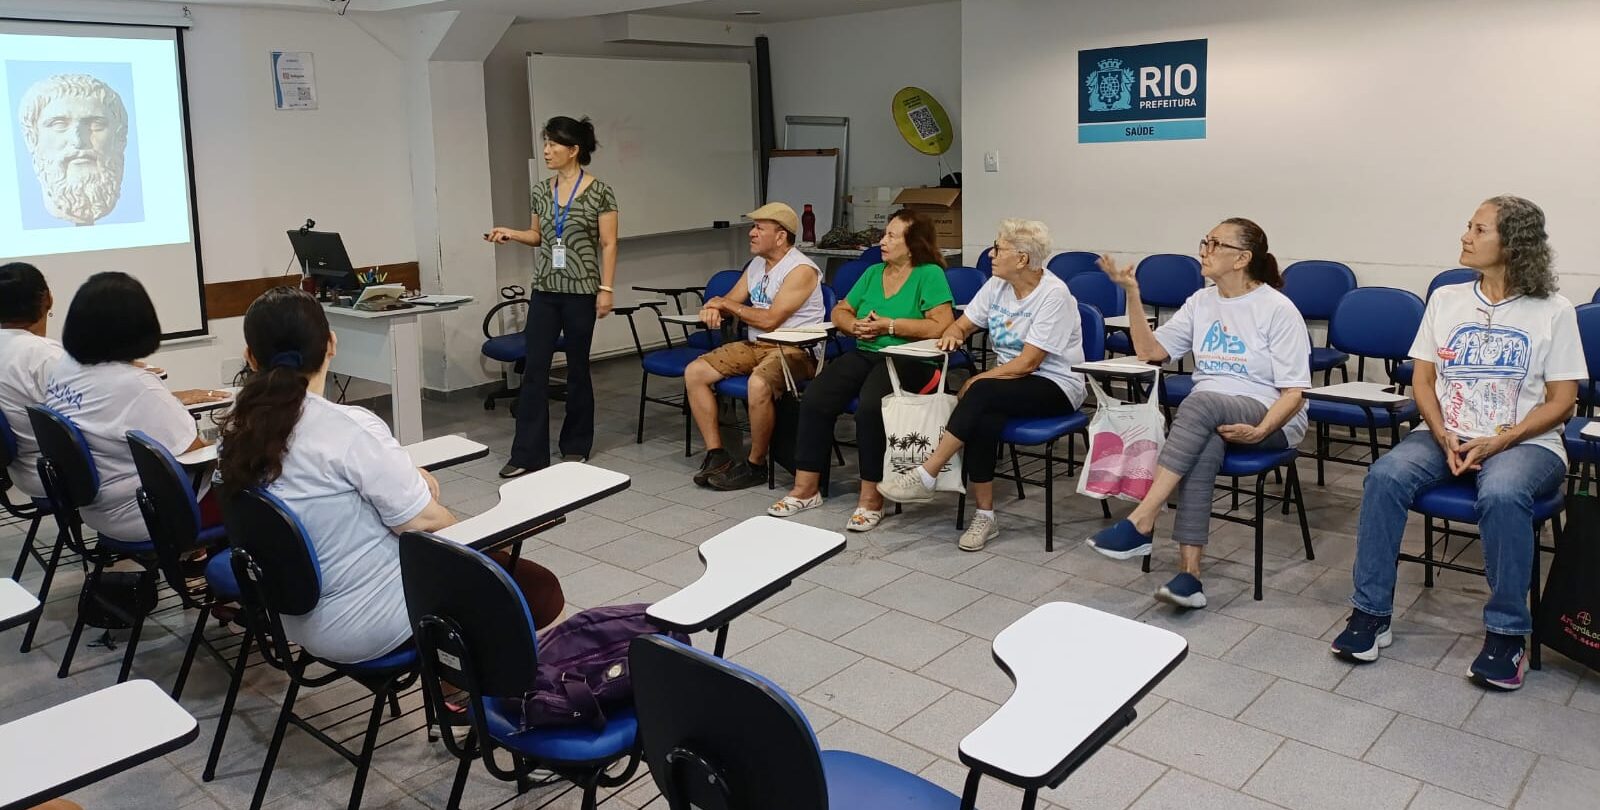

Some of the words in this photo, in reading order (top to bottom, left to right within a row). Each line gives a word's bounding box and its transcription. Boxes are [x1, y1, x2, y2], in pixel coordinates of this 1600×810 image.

[1139, 63, 1198, 98] RIO
[1139, 98, 1197, 109] PREFEITURA
[1125, 124, 1155, 137] SAÚDE
[1198, 360, 1249, 376] CARIOCA
